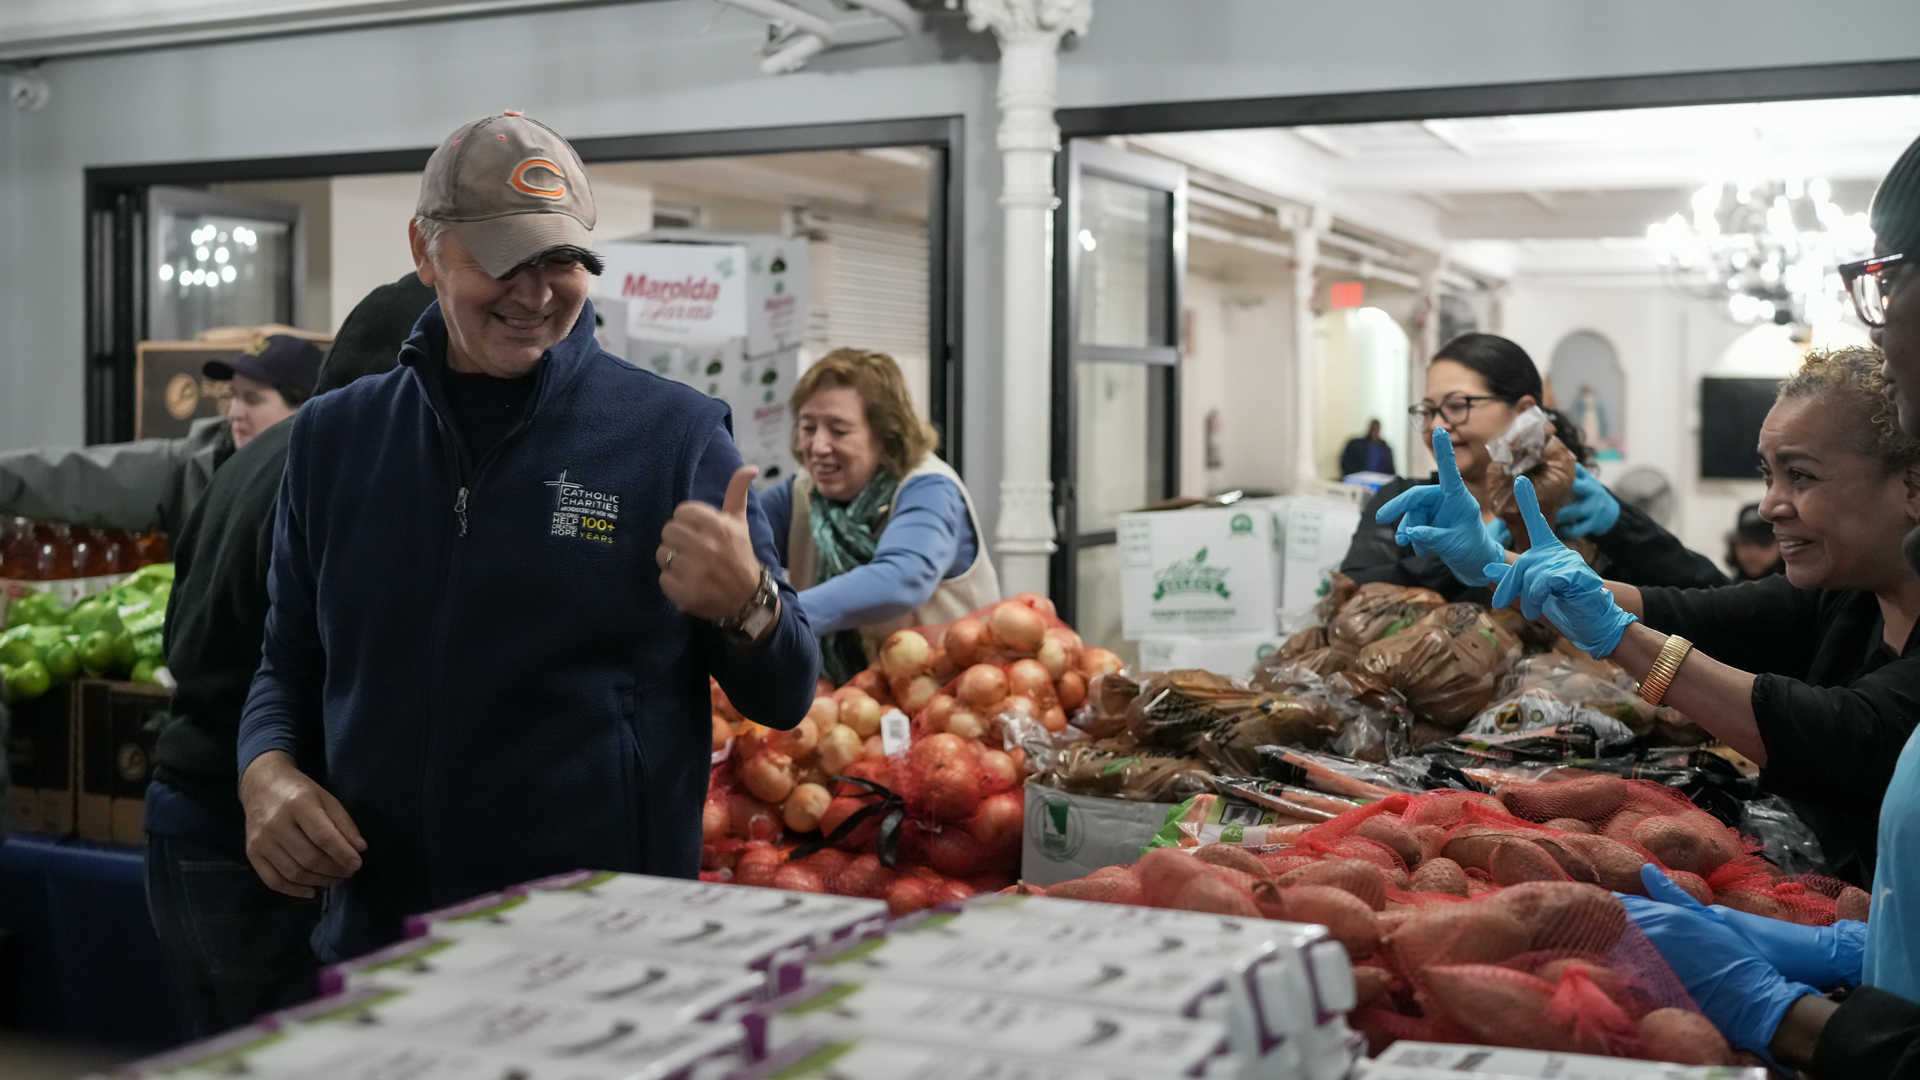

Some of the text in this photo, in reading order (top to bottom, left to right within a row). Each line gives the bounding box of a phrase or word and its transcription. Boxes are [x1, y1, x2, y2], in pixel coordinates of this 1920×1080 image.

[505, 156, 567, 200] C
[563, 488, 620, 503] CATHOLIC
[561, 497, 619, 512] CHARITIES
[552, 516, 579, 525] HELP
[581, 516, 615, 531] 100+
[551, 529, 577, 537] HOPE
[580, 531, 614, 543] YEARS
